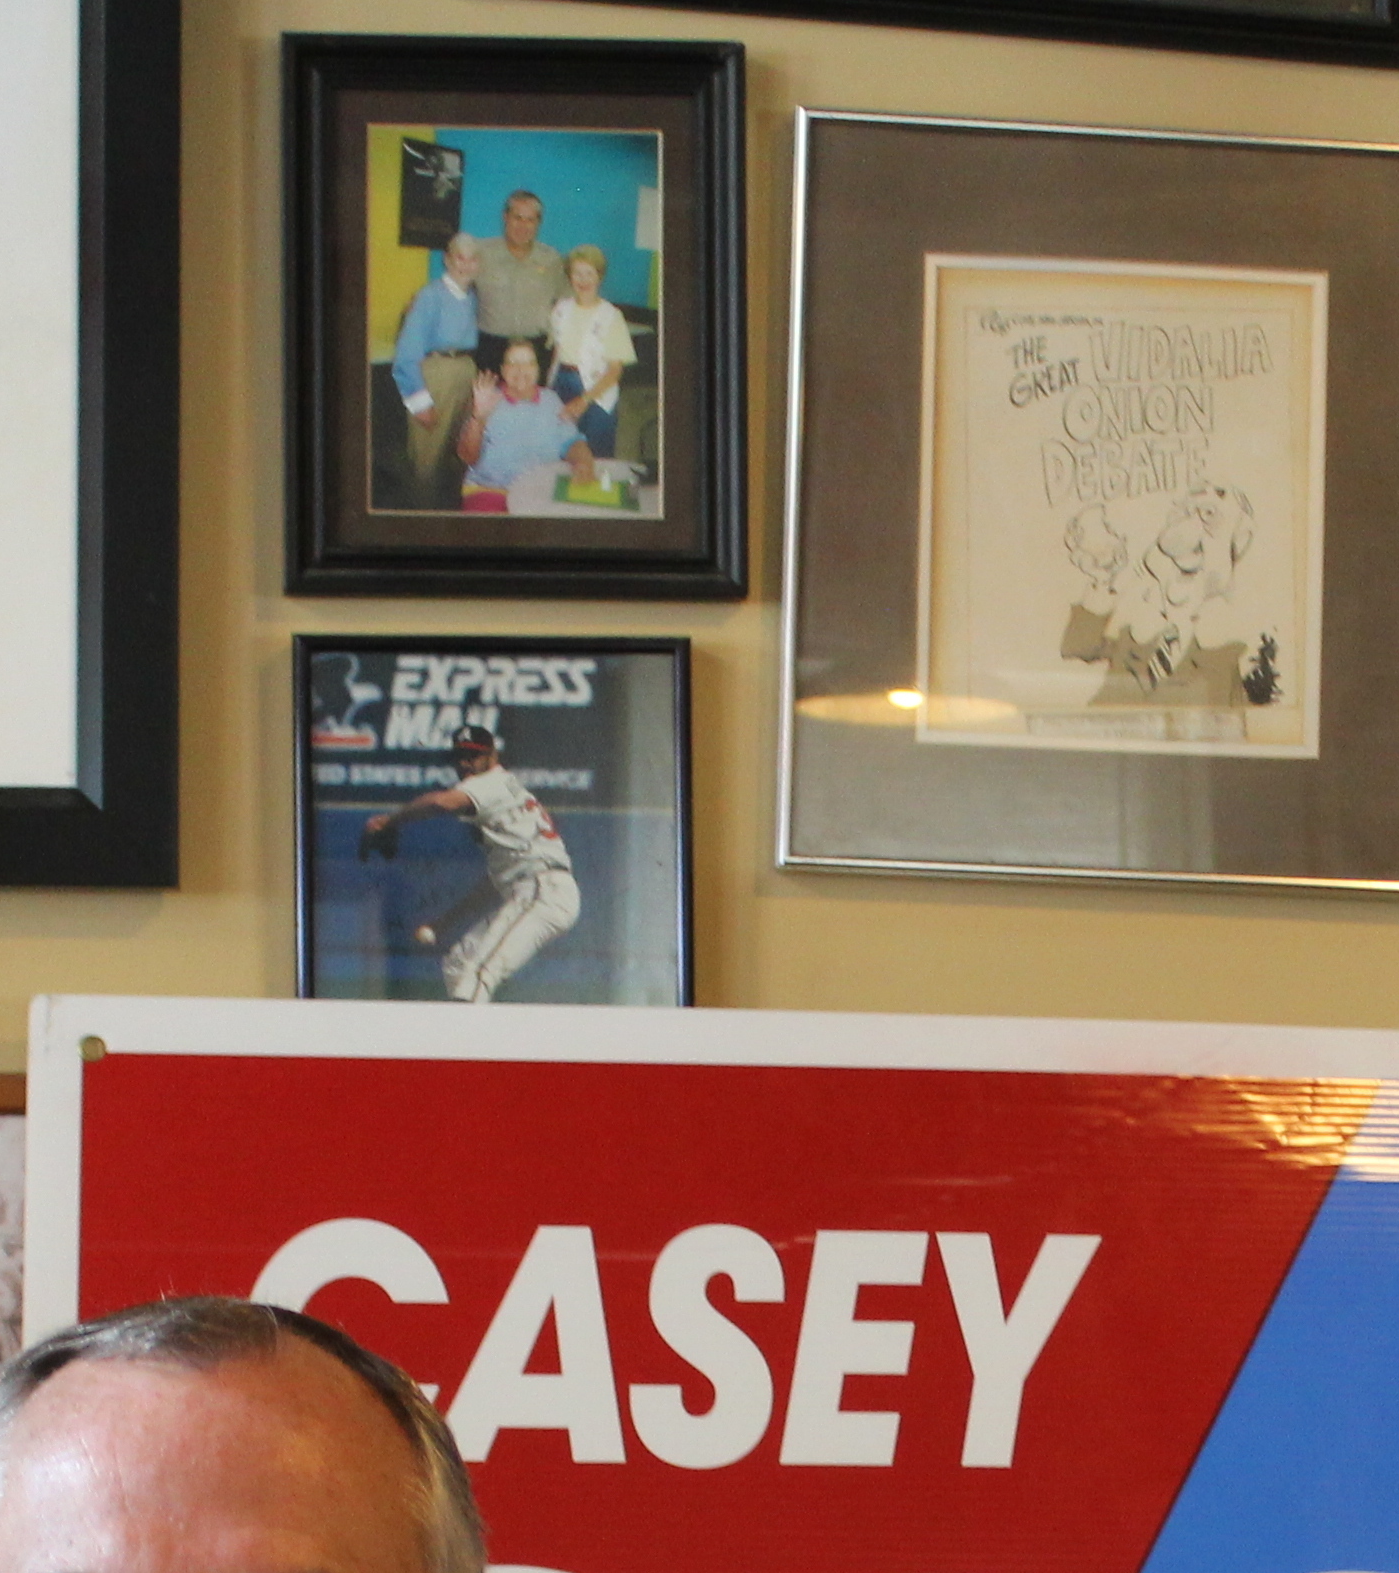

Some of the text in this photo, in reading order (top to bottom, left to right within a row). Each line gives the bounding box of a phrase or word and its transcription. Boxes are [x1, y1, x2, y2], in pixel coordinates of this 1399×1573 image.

[1010, 335, 1049, 369] THE
[1008, 357, 1080, 409] GREAT
[1061, 383, 1215, 443] ONION
[1040, 437, 1211, 507] DEBATE
[390, 653, 598, 708] EXPRESS
[249, 1217, 1101, 1469] CASEY
